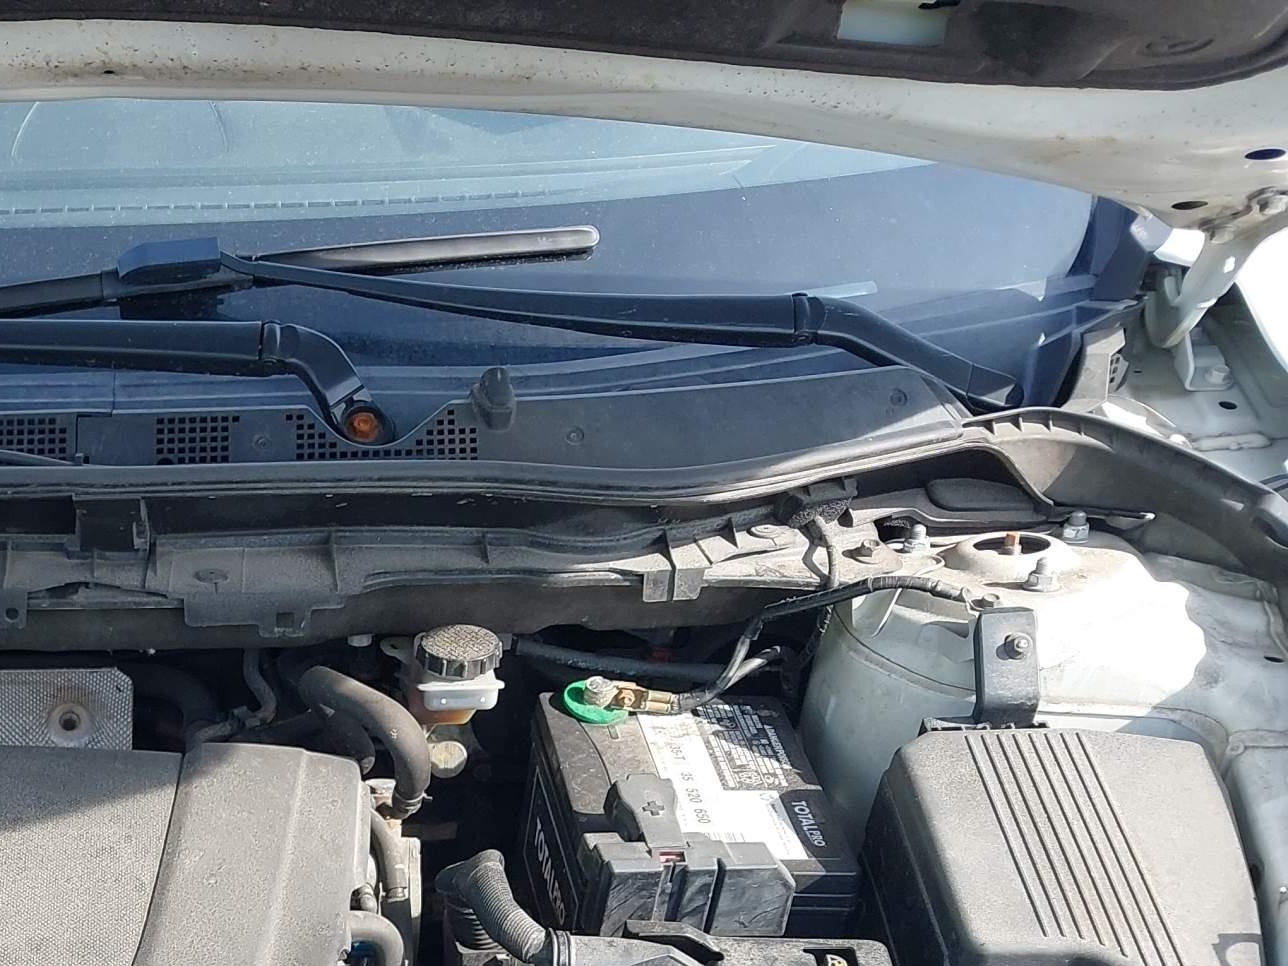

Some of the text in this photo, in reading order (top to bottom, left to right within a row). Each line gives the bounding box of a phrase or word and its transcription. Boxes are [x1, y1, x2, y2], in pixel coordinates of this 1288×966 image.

[680, 771, 694, 782] 35
[685, 786, 703, 804] 520
[693, 807, 712, 825] 650
